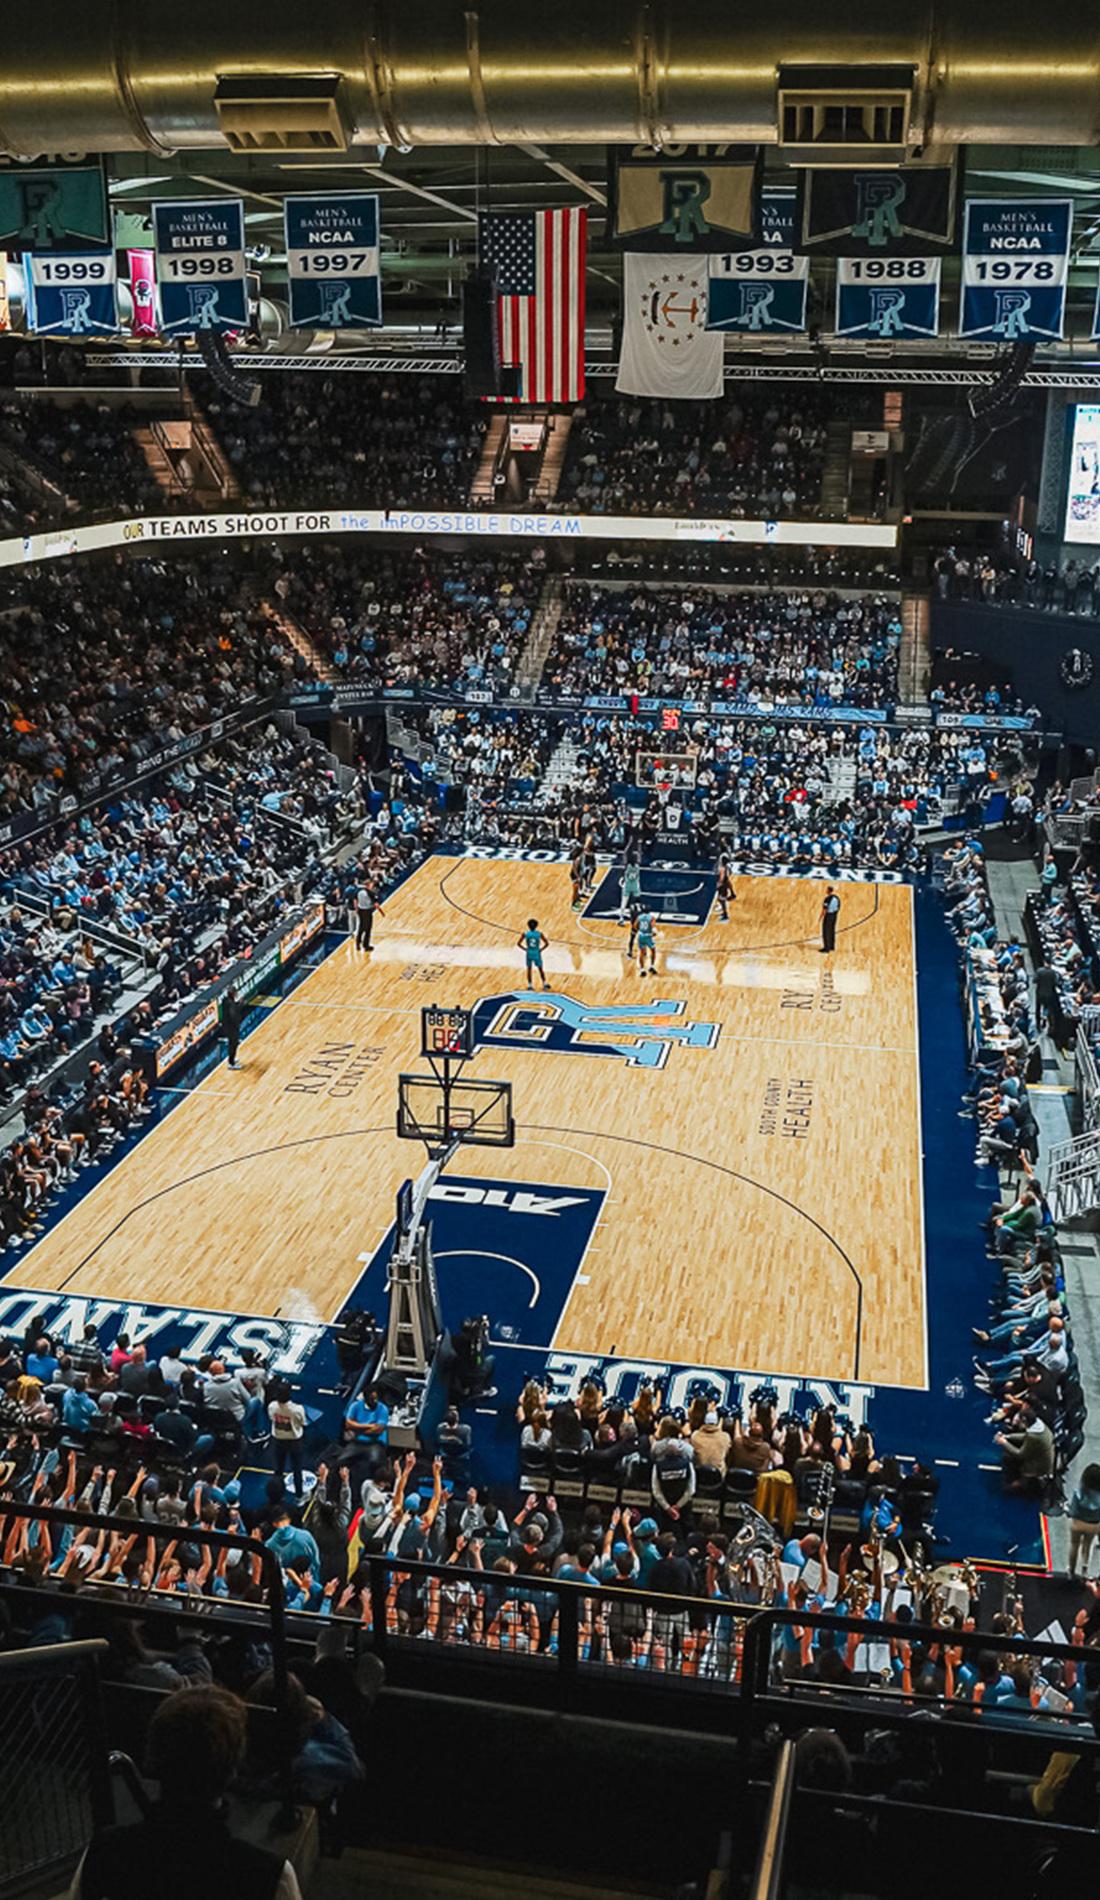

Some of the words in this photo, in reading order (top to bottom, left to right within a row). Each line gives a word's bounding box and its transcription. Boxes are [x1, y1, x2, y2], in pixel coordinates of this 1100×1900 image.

[181, 212, 214, 223] MEN'S
[314, 207, 348, 218] MEN'S
[1001, 211, 1037, 222] MEN'S
[169, 221, 229, 233] BASKETBALL
[300, 217, 363, 228] BASKETBALL
[982, 222, 1053, 233] BASKETBALL
[171, 235, 214, 248] ELITE
[217, 235, 228, 246] 8
[308, 231, 355, 244] NCAA
[990, 237, 1042, 249] NCAA
[42, 262, 105, 280] 1999
[168, 257, 234, 276] 1998
[299, 253, 367, 272] 1997
[721, 255, 795, 273] 1993
[851, 260, 927, 278] 1988
[976, 261, 1054, 280] 1978
[149, 519, 218, 536] TEAMS
[225, 516, 288, 533] SHOOT
[295, 515, 331, 530] FOR
[341, 516, 369, 529] the
[510, 517, 581, 534] DREAM
[727, 861, 902, 884] ISLAND
[284, 1041, 356, 1095] RYAN
[327, 1046, 388, 1098] CENTER
[781, 1078, 814, 1139] HEALTH
[759, 1109, 777, 1136] SOUTH
[0, 1290, 328, 1375] ISLAND
